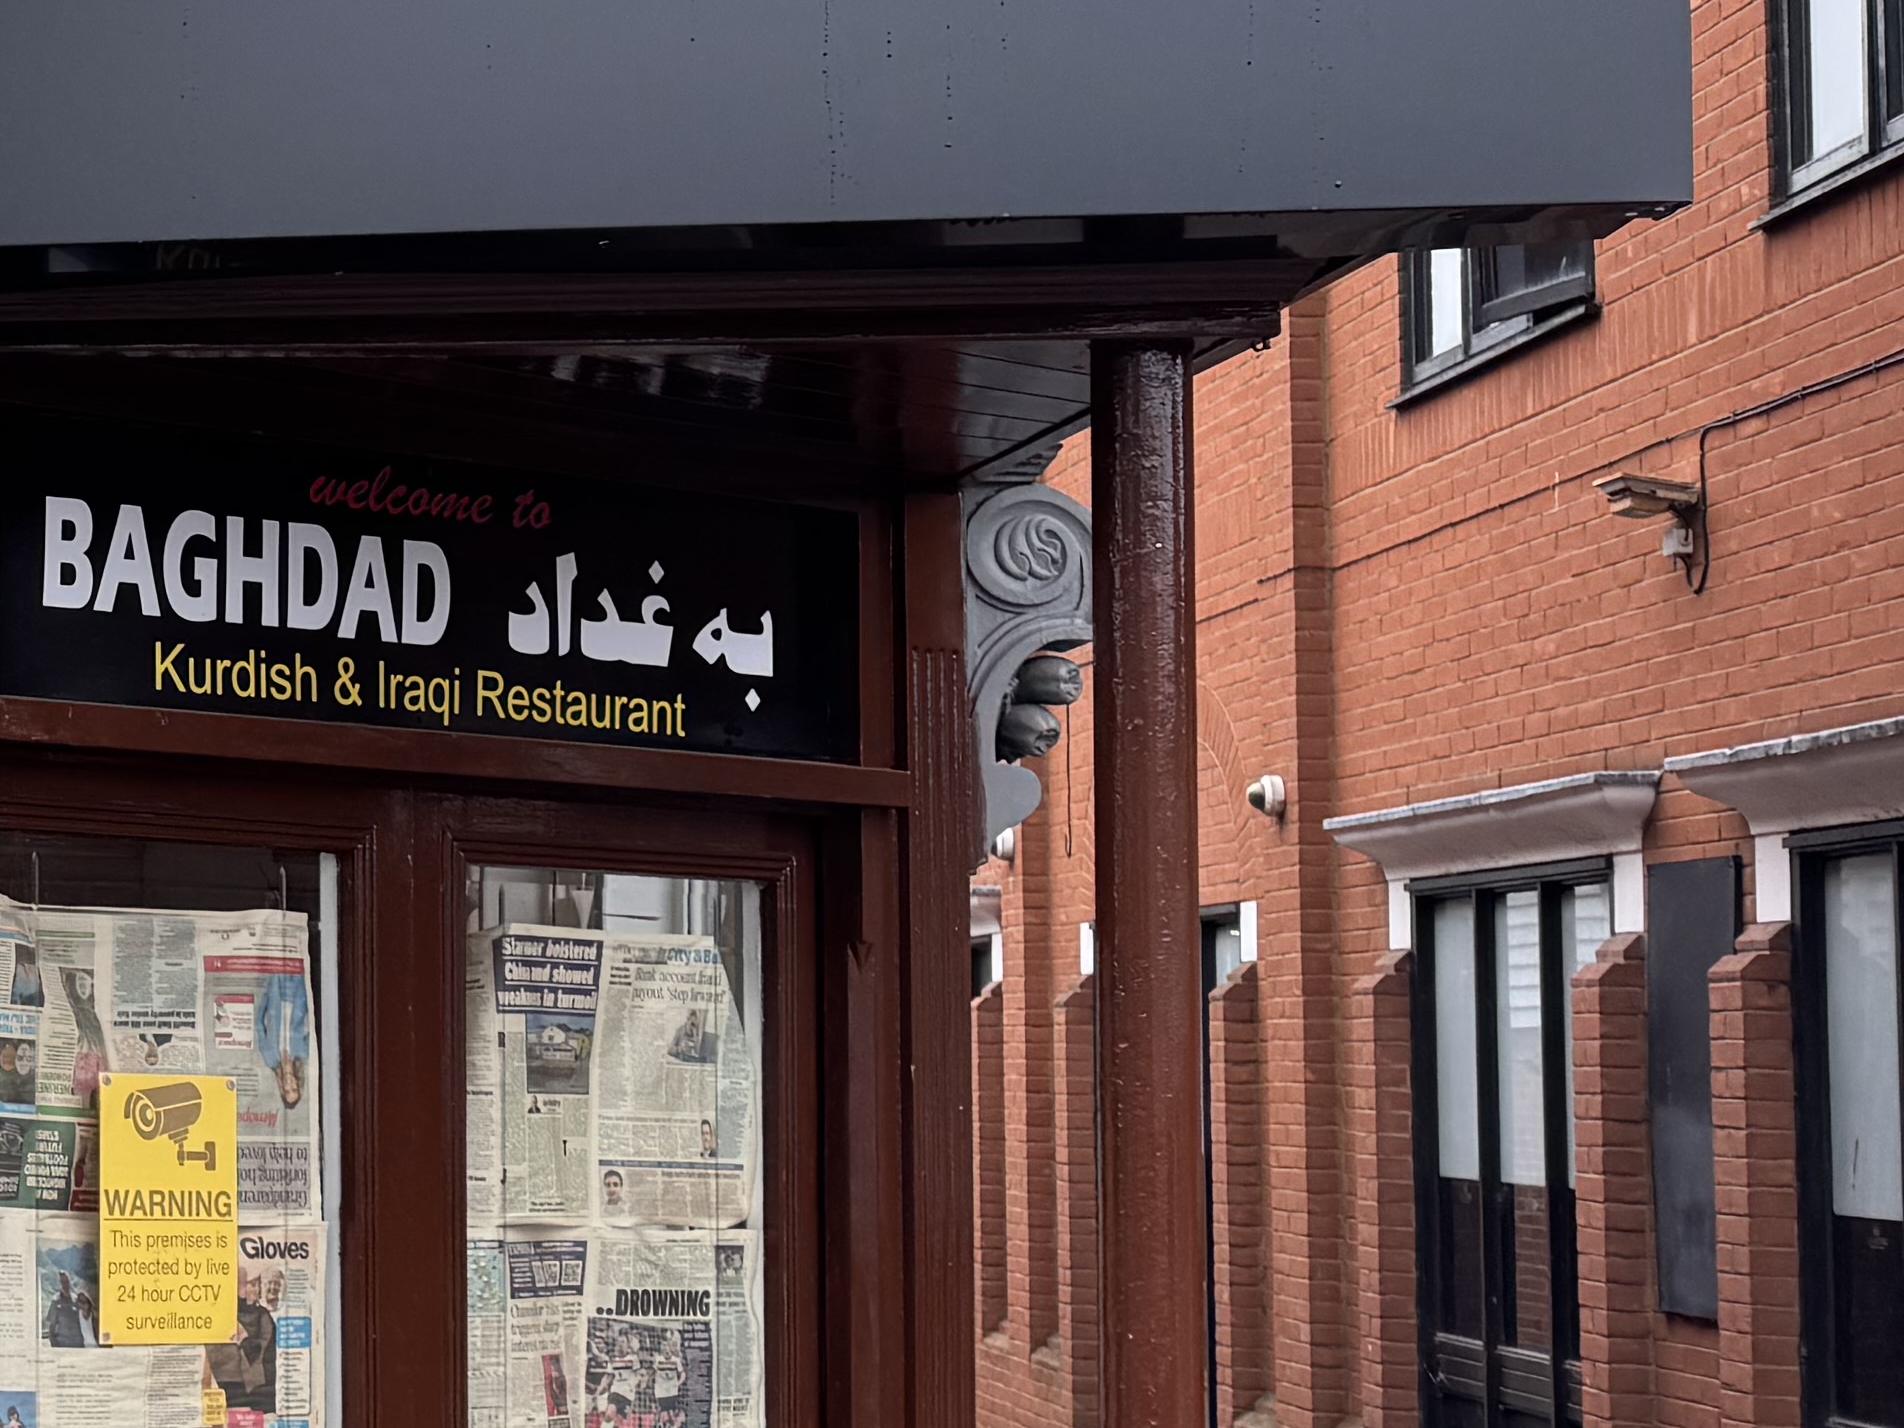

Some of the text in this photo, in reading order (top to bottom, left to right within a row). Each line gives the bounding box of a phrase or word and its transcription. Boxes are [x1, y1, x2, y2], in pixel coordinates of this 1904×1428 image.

[309, 465, 553, 530] welcome to
[42, 496, 451, 646] BAGHDAD
[153, 642, 687, 738] Kurdish & Iraqi Restaurant
[546, 939, 597, 960] bolstered
[552, 965, 594, 985] showed
[268, 1143, 292, 1164] help
[297, 1147, 307, 1163] to
[104, 1189, 232, 1218] WARNING
[111, 1230, 228, 1254] This premises is
[240, 1236, 310, 1260] Gloves
[108, 1257, 230, 1281] protected by live
[117, 1285, 221, 1304] 24 hour CCTV
[126, 1312, 212, 1330] surveillance
